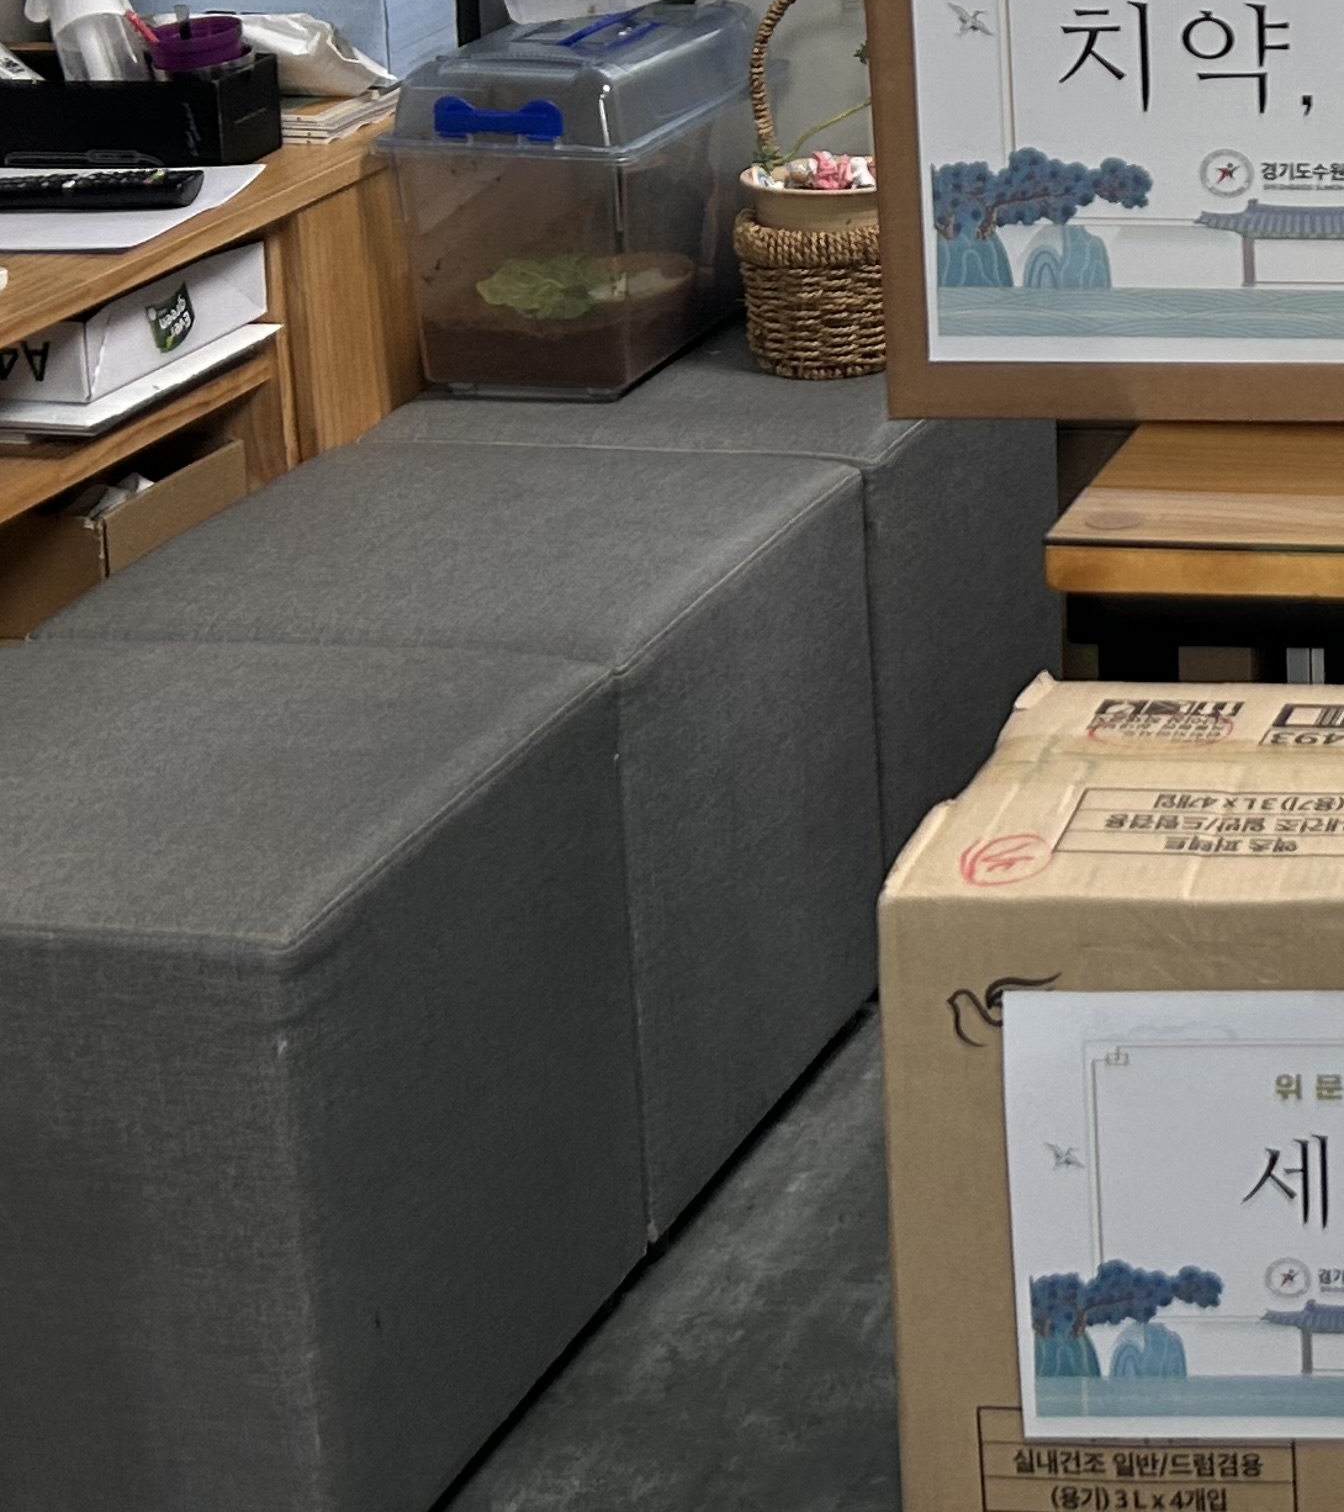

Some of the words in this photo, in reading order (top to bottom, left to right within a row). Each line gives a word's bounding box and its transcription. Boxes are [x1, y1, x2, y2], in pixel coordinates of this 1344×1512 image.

[1274, 1073, 1342, 1102] 위문
[1013, 1449, 1106, 1475] 실내건조
[1112, 1451, 1263, 1478] 일반/드럼겸용
[1051, 1485, 1109, 1511] (용기)
[1170, 1488, 1227, 1511] 4개입
